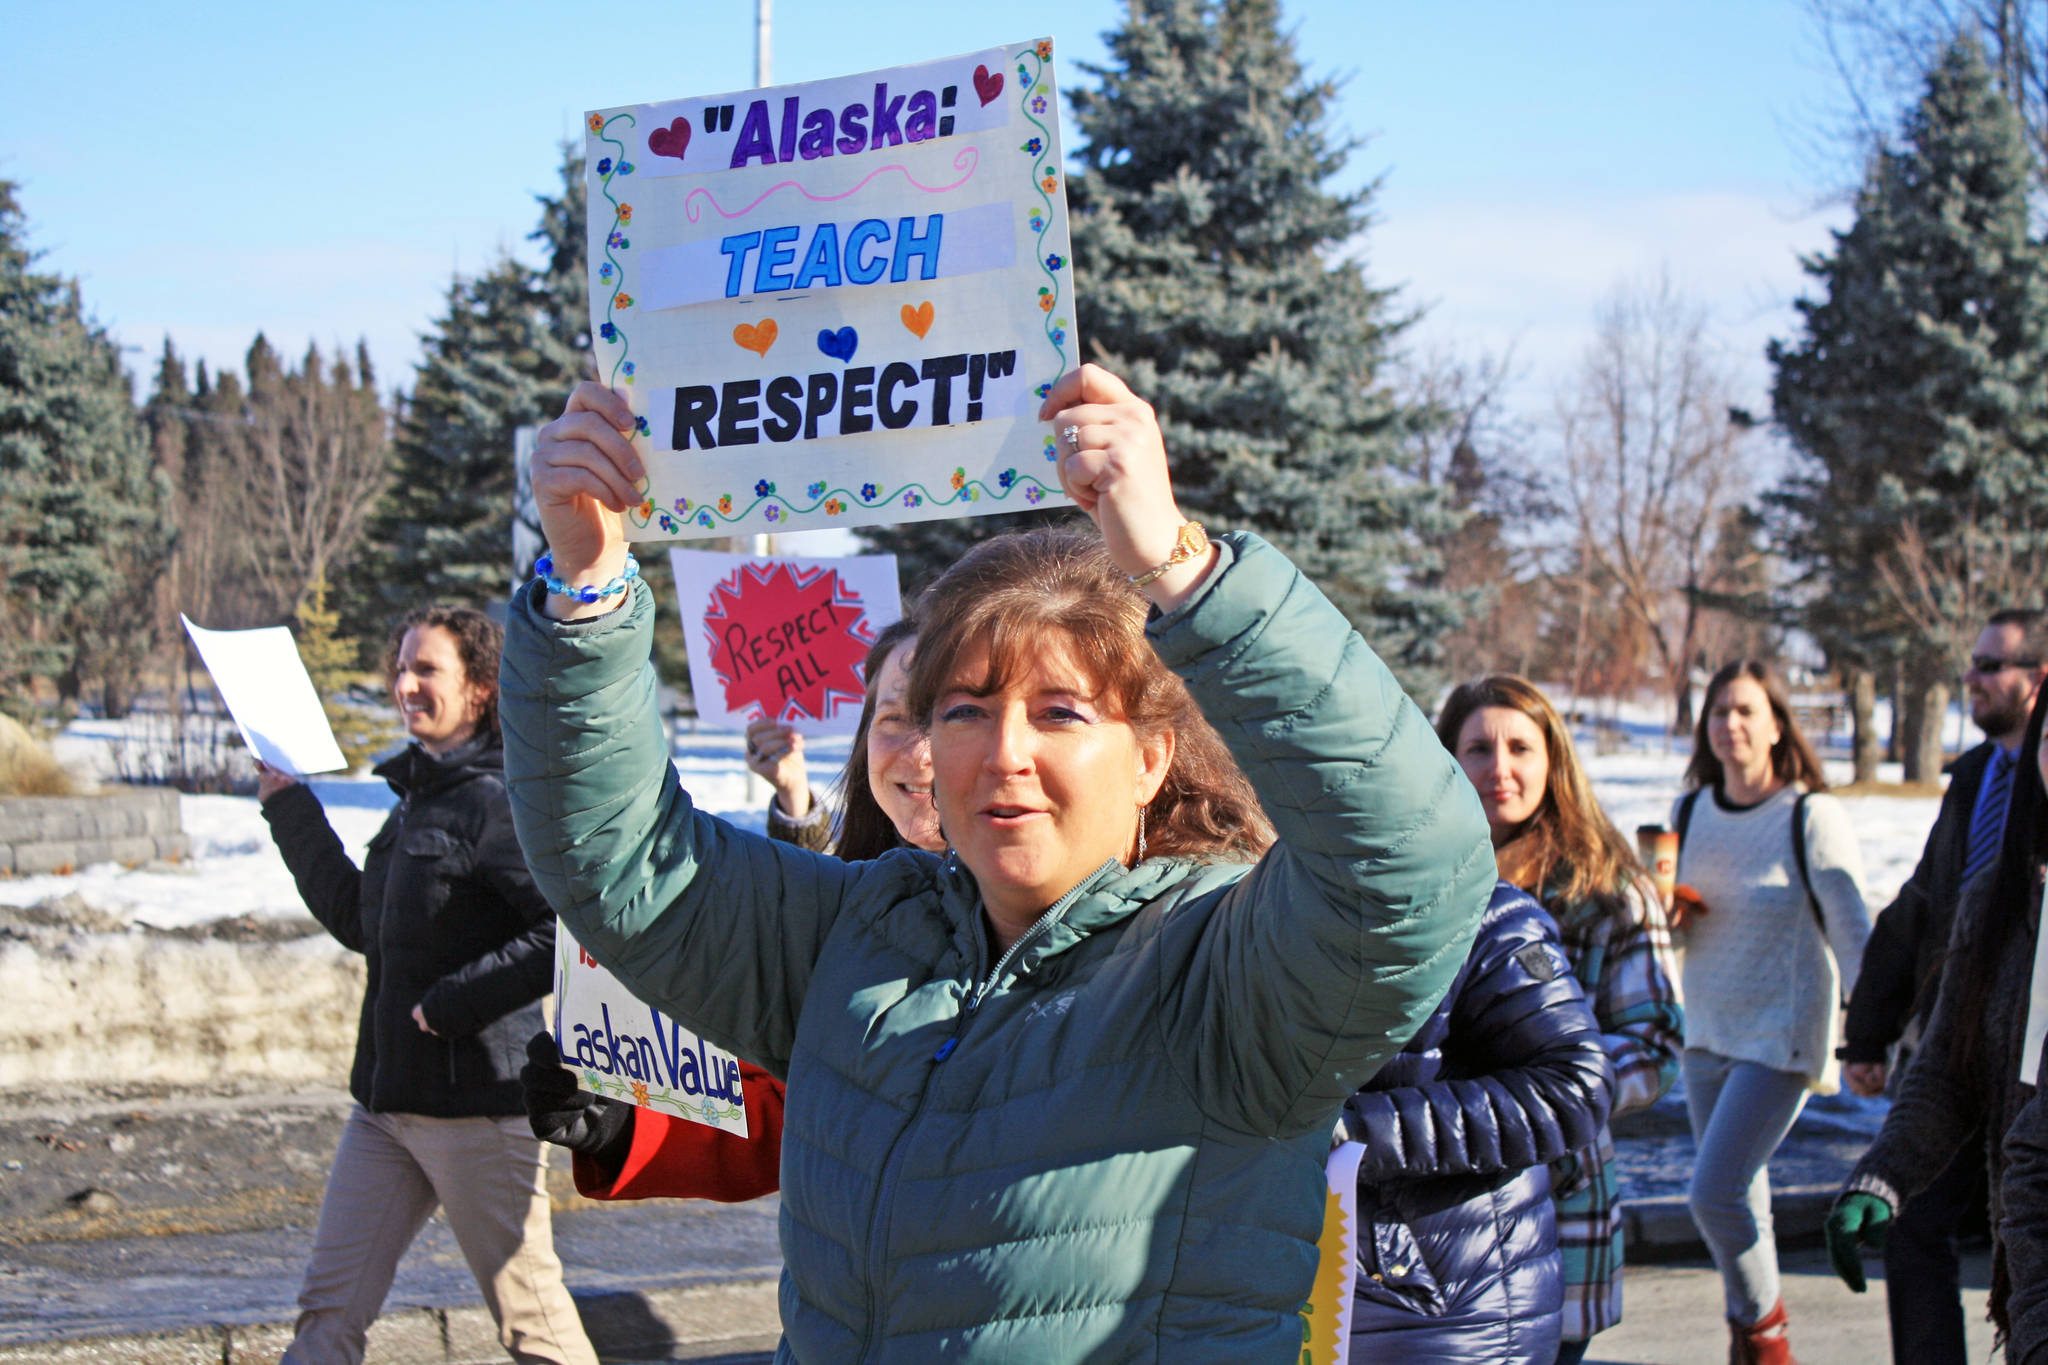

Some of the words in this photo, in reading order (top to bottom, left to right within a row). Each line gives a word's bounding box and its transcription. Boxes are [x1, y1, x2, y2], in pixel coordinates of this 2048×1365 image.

[703, 82, 958, 170] "Alaska:
[720, 213, 944, 299] TEACH
[671, 350, 1017, 451] RESPECT!"
[725, 598, 839, 681] RESPECT
[776, 652, 830, 700] ALL
